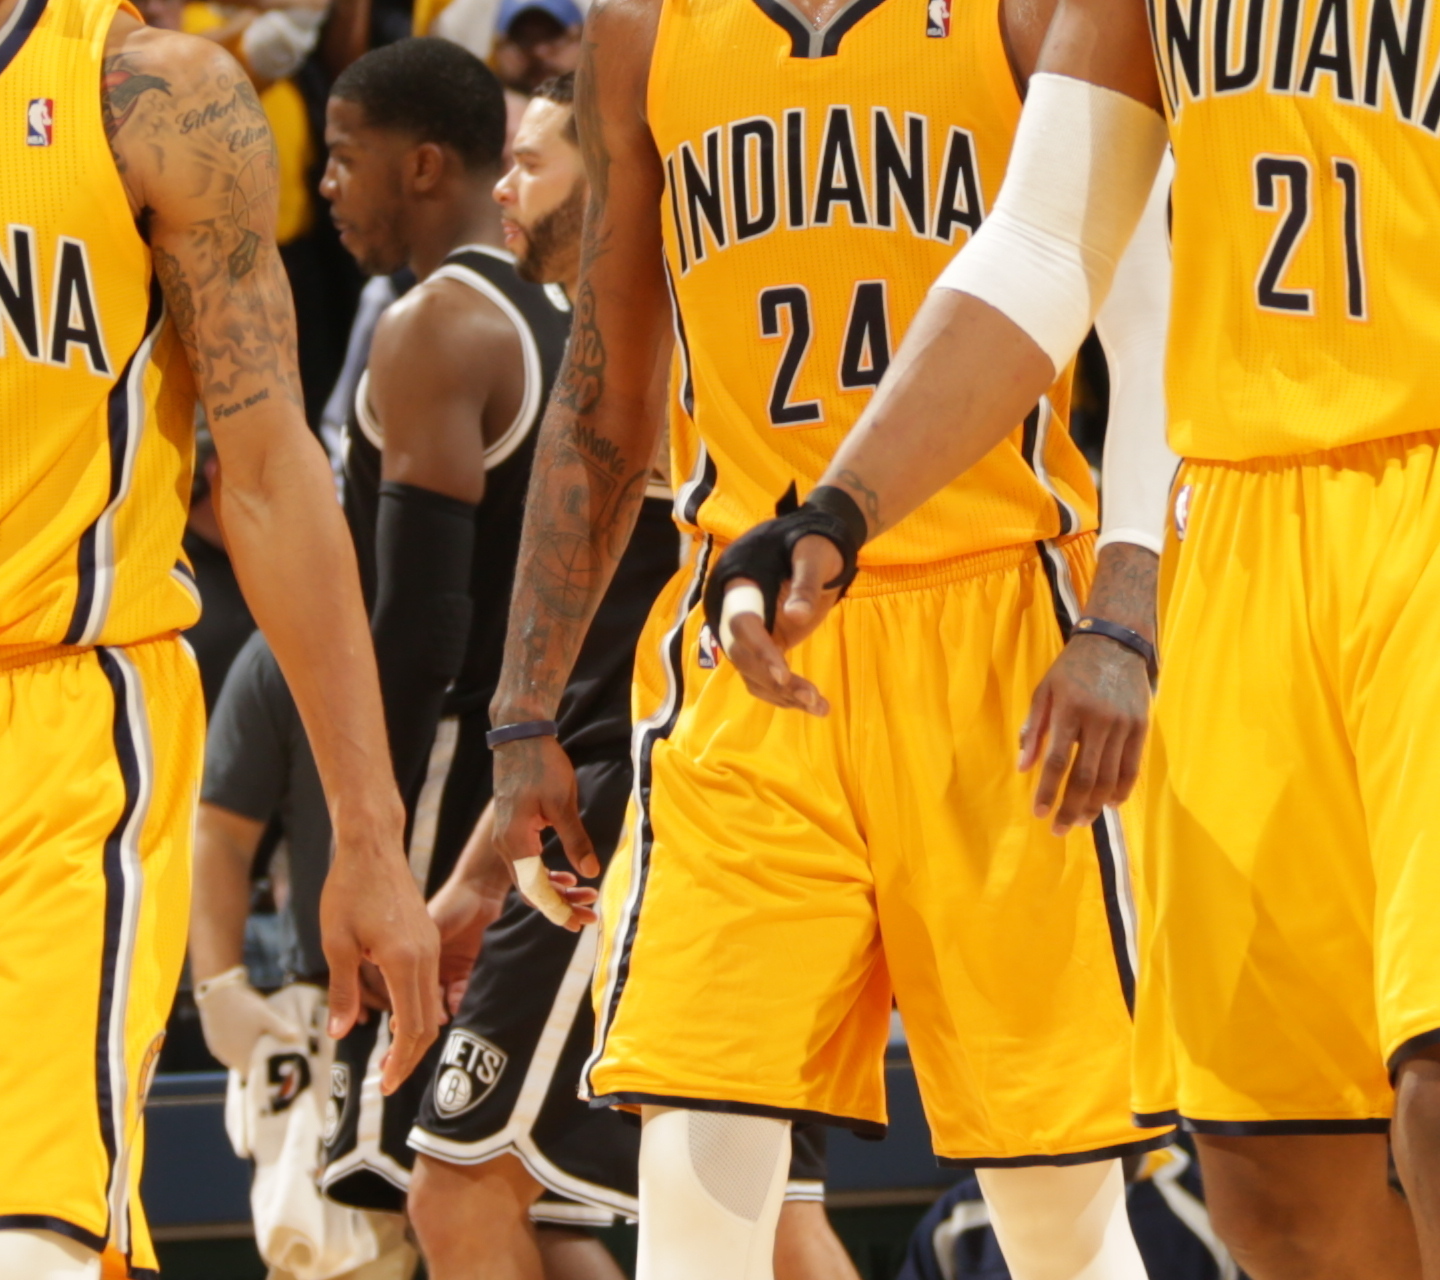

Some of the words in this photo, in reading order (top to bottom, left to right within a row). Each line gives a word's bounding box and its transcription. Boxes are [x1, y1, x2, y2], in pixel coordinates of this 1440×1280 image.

[664, 104, 987, 279] INDIANA
[1253, 153, 1369, 322] 21
[759, 278, 894, 427] 24
[441, 1029, 503, 1086] NETS
